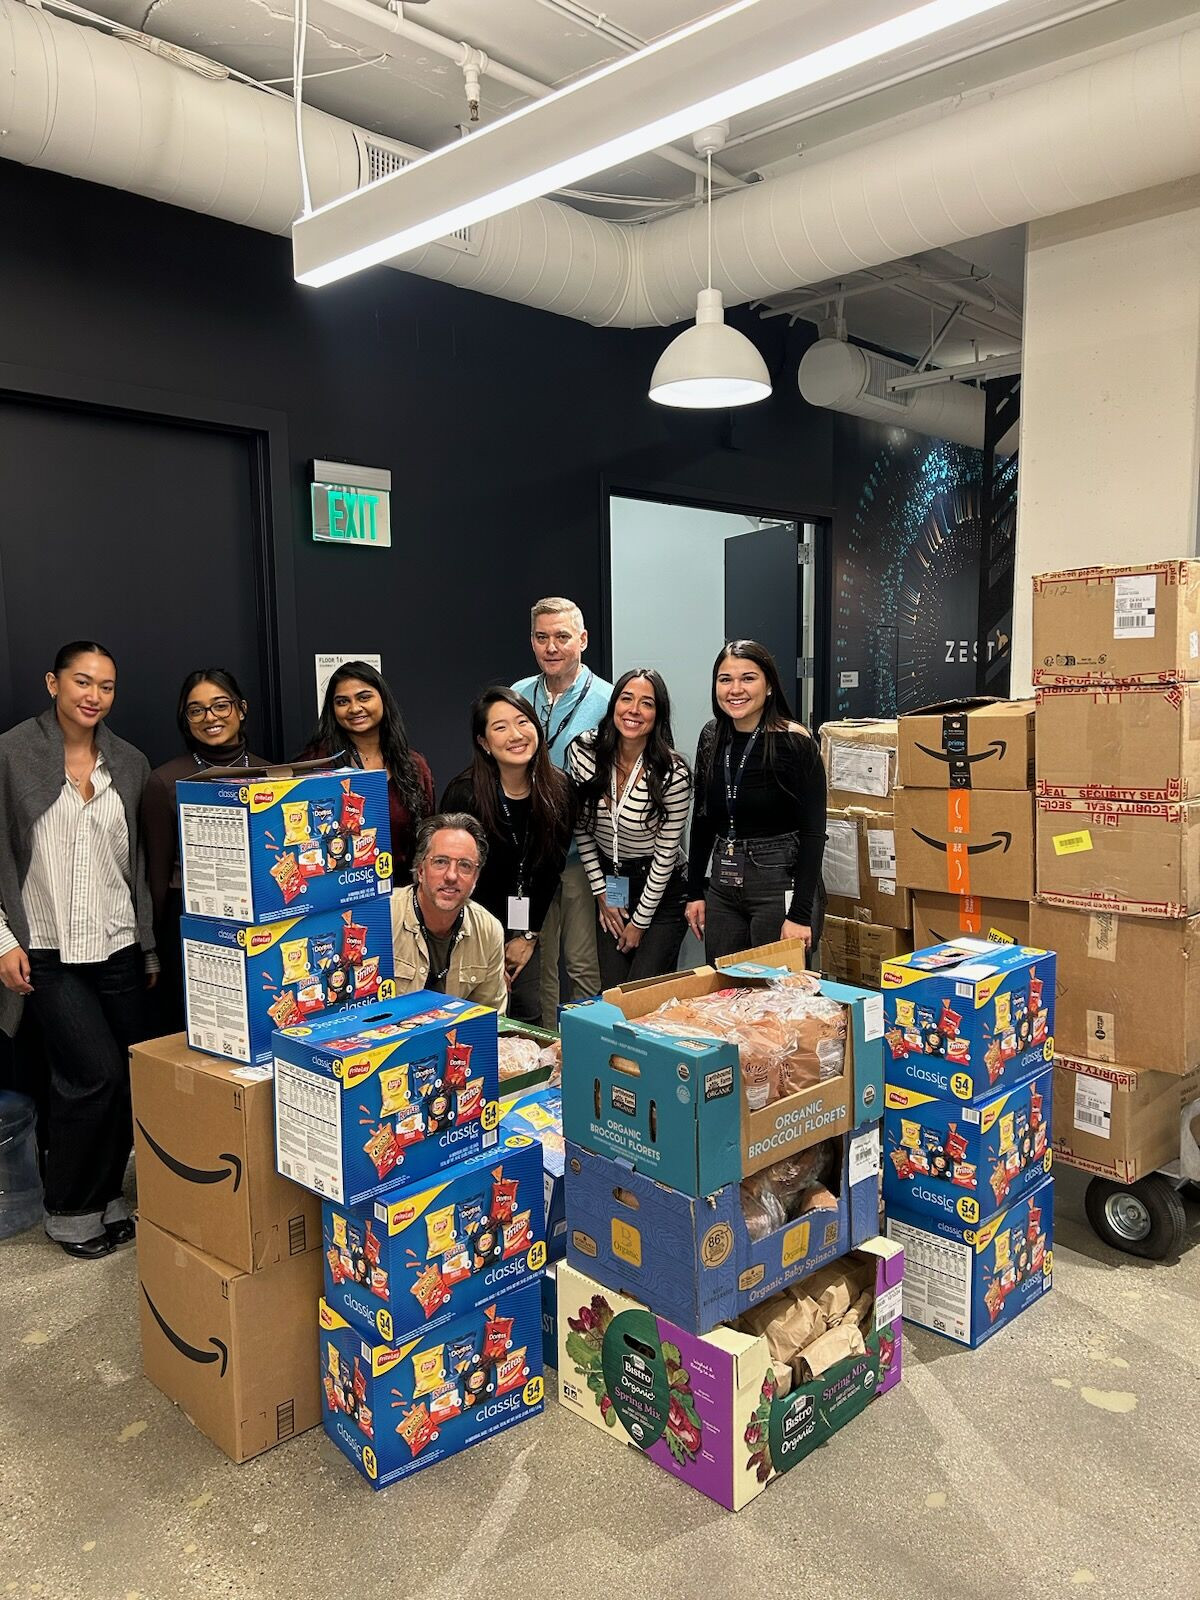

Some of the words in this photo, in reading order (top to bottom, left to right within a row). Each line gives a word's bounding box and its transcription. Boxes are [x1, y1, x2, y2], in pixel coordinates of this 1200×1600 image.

[328, 490, 379, 540] EXIT
[218, 789, 238, 799] classic
[1080, 789, 1136, 799] SECURITY
[314, 809, 332, 817] Doritos
[346, 806, 360, 814] Doritos
[1084, 802, 1113, 811] SEAL
[355, 836, 373, 851] Fritos
[378, 856, 390, 867] 54
[338, 868, 374, 885] classic
[218, 930, 237, 941] classic
[346, 936, 362, 945] Doritos
[314, 943, 333, 954] Doritos
[357, 964, 377, 982] Fritos
[381, 984, 393, 997] 54
[950, 1042, 968, 1050] Fritos
[312, 1056, 332, 1070] classic
[1021, 1049, 1044, 1067] classic
[334, 1064, 342, 1074] 54
[415, 1068, 435, 1079] Doritos
[706, 1069, 733, 1083] Earthbound
[906, 1065, 948, 1086] classic
[707, 1087, 733, 1099] ORGANIC
[955, 1077, 969, 1092] 54
[460, 1086, 480, 1107] Fritos
[485, 1104, 497, 1121] 54
[613, 1101, 635, 1115] ORGANIC
[775, 1100, 823, 1129] ORGANIC
[439, 1122, 479, 1147] classic
[607, 1120, 641, 1141] ORGANIC
[748, 1124, 802, 1159] BROCCOLI
[805, 1105, 847, 1133] FLORETS
[590, 1123, 626, 1146] BROCCOLI
[629, 1140, 661, 1161] FLORETS
[956, 1167, 974, 1175] Fritos
[1025, 1162, 1044, 1183] classic
[912, 1187, 954, 1209] classic
[462, 1206, 481, 1217] Doritos
[962, 1201, 976, 1215] 54
[507, 1220, 526, 1241] Fritos
[938, 1222, 963, 1237] classic
[965, 1231, 975, 1241] 54
[531, 1245, 543, 1262] 54
[485, 1258, 525, 1286] classic
[750, 1277, 783, 1302] Organic
[784, 1265, 804, 1281] Baby
[805, 1246, 837, 1270] Spinach
[1021, 1274, 1043, 1292] classic
[344, 1294, 375, 1322] classic
[380, 1316, 391, 1333] 54
[489, 1333, 506, 1341] Doritos
[451, 1344, 473, 1358] Doritos
[500, 1357, 522, 1378] Fritos
[625, 1362, 651, 1384] Bistro
[527, 1380, 541, 1398] 54
[622, 1376, 655, 1401] Organic
[823, 1375, 851, 1401] Spring
[852, 1363, 868, 1379] Mix
[476, 1393, 521, 1422] classic
[510, 1404, 520, 1412] MIX
[614, 1387, 643, 1411] Spring
[644, 1405, 661, 1421] Mix
[786, 1406, 812, 1433] Bistro
[337, 1422, 362, 1457] classic
[781, 1422, 816, 1455] Organic
[366, 1452, 375, 1468] 54
